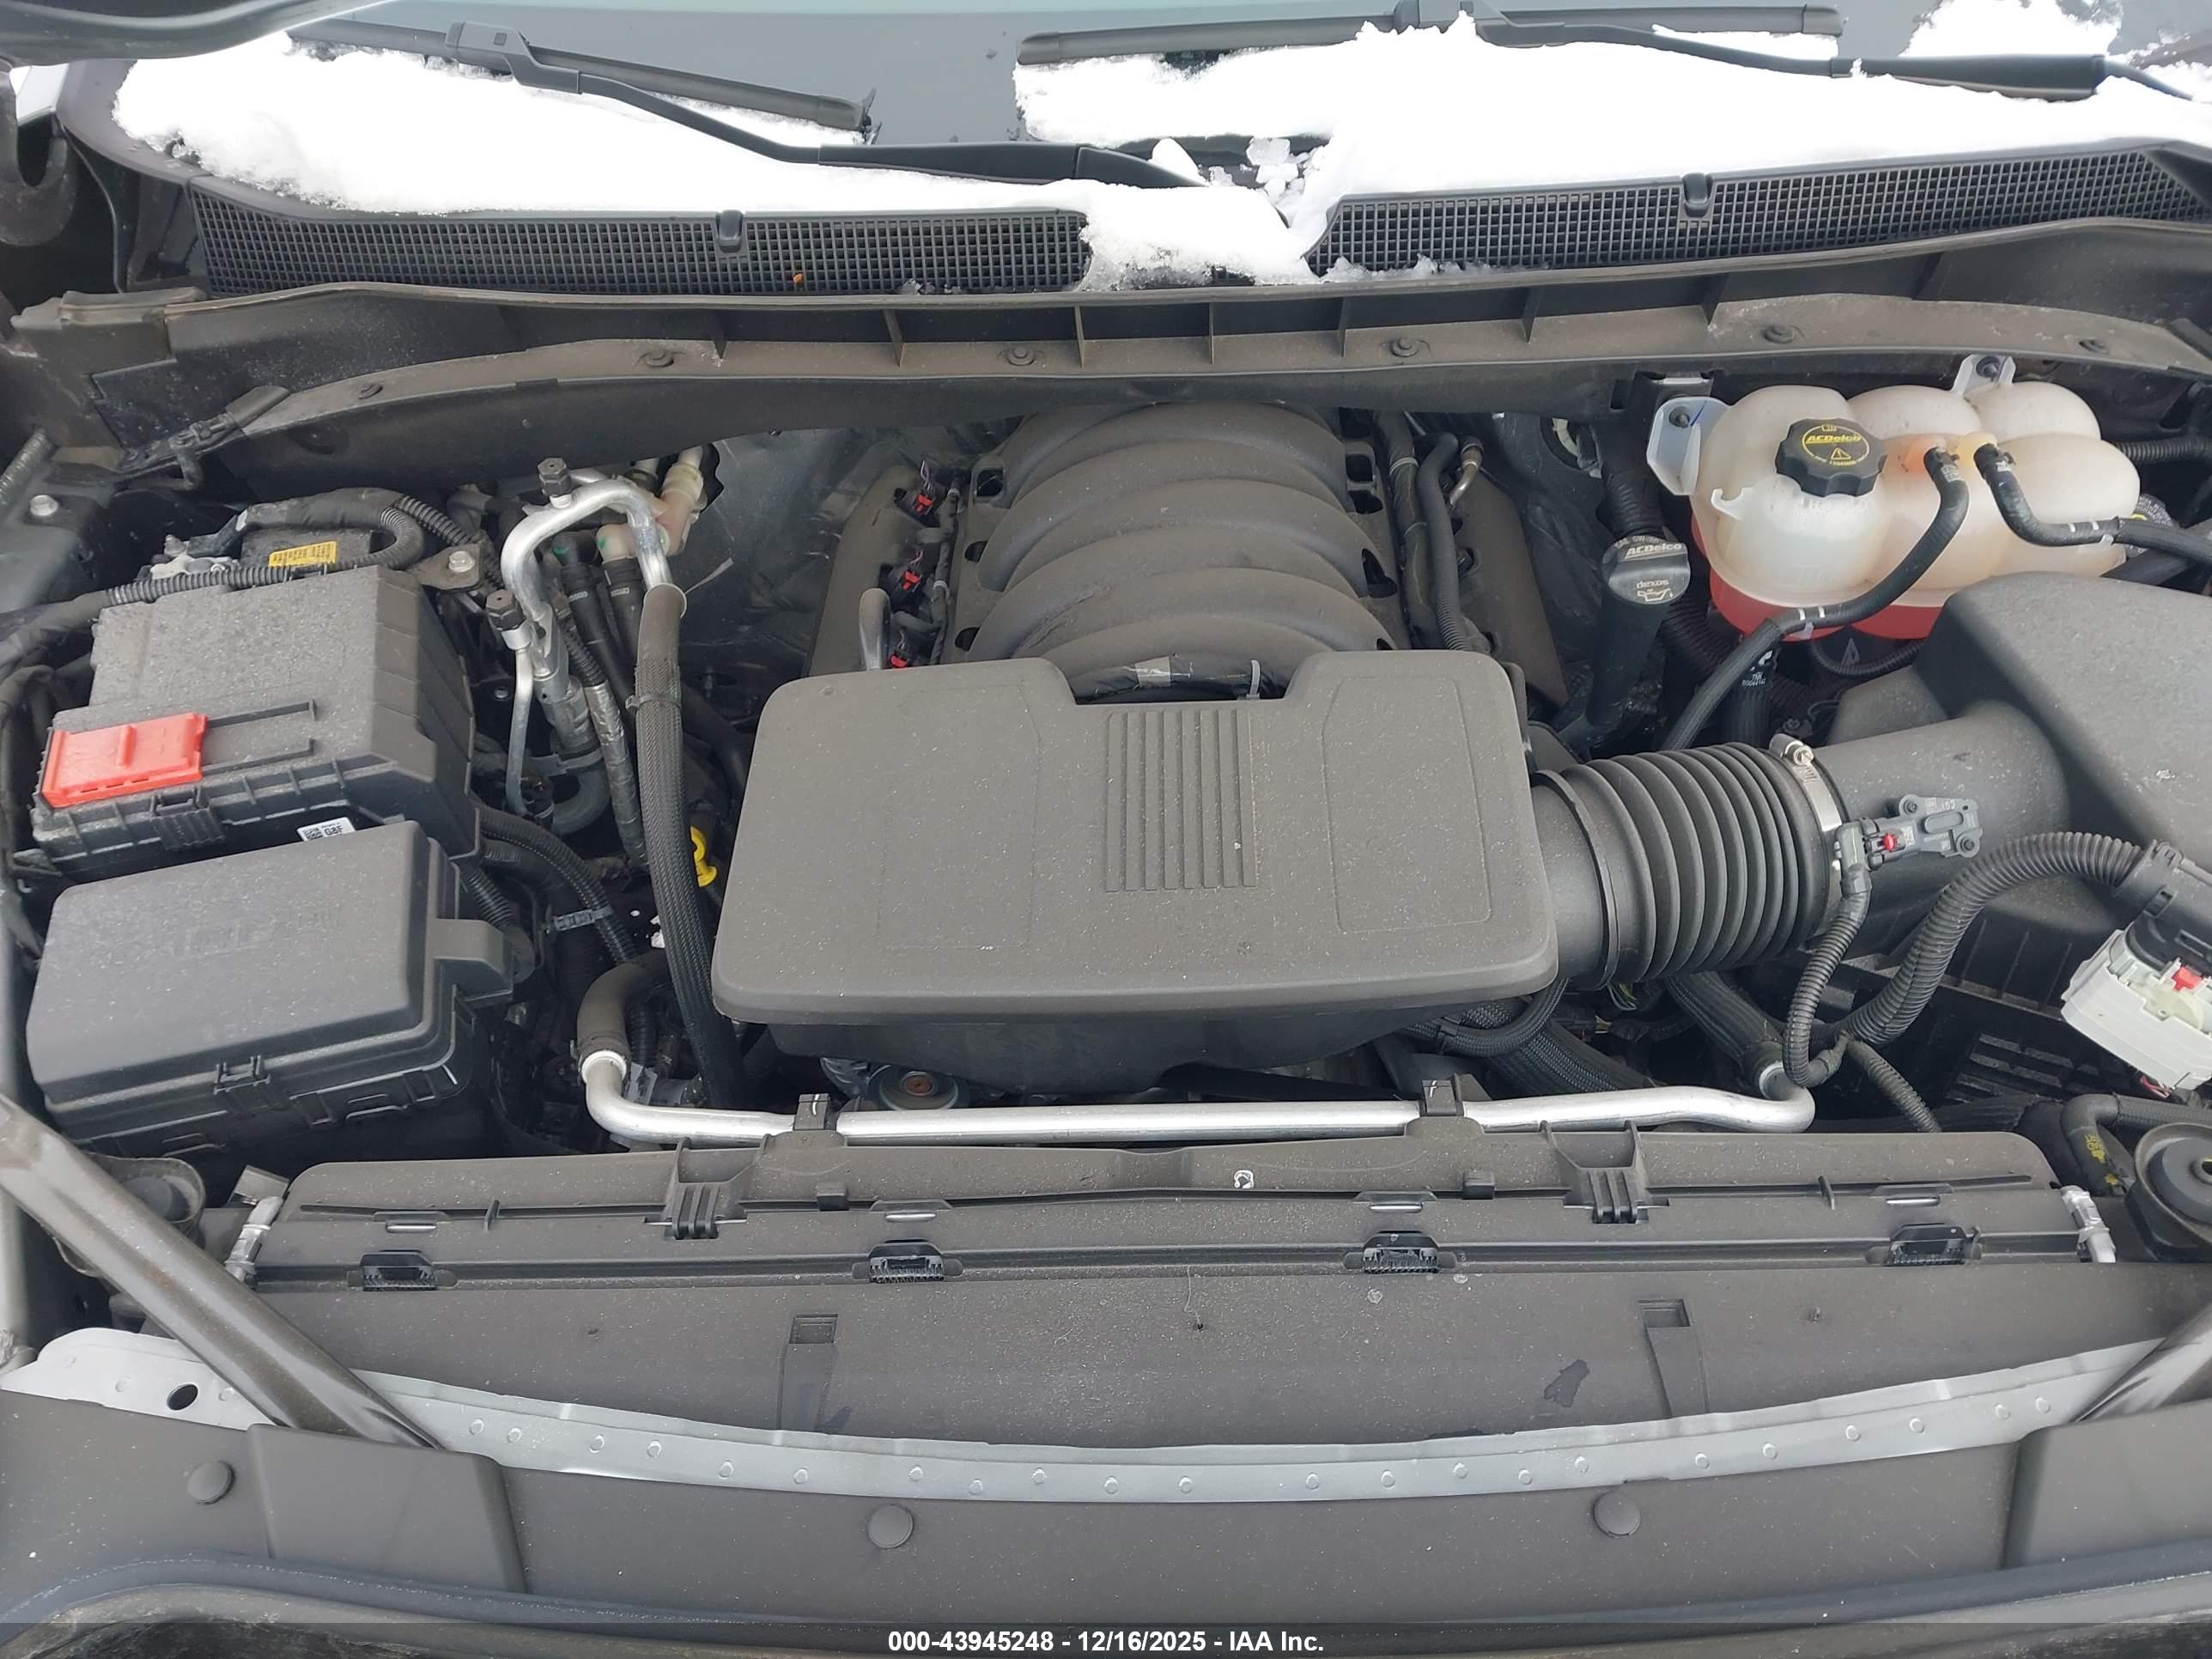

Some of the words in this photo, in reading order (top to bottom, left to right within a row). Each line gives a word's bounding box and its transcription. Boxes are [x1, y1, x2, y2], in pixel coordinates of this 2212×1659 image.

[1806, 434, 1862, 443] ACDelco
[1625, 543, 1683, 559] ACDelco
[1636, 579, 1669, 589] dexos
